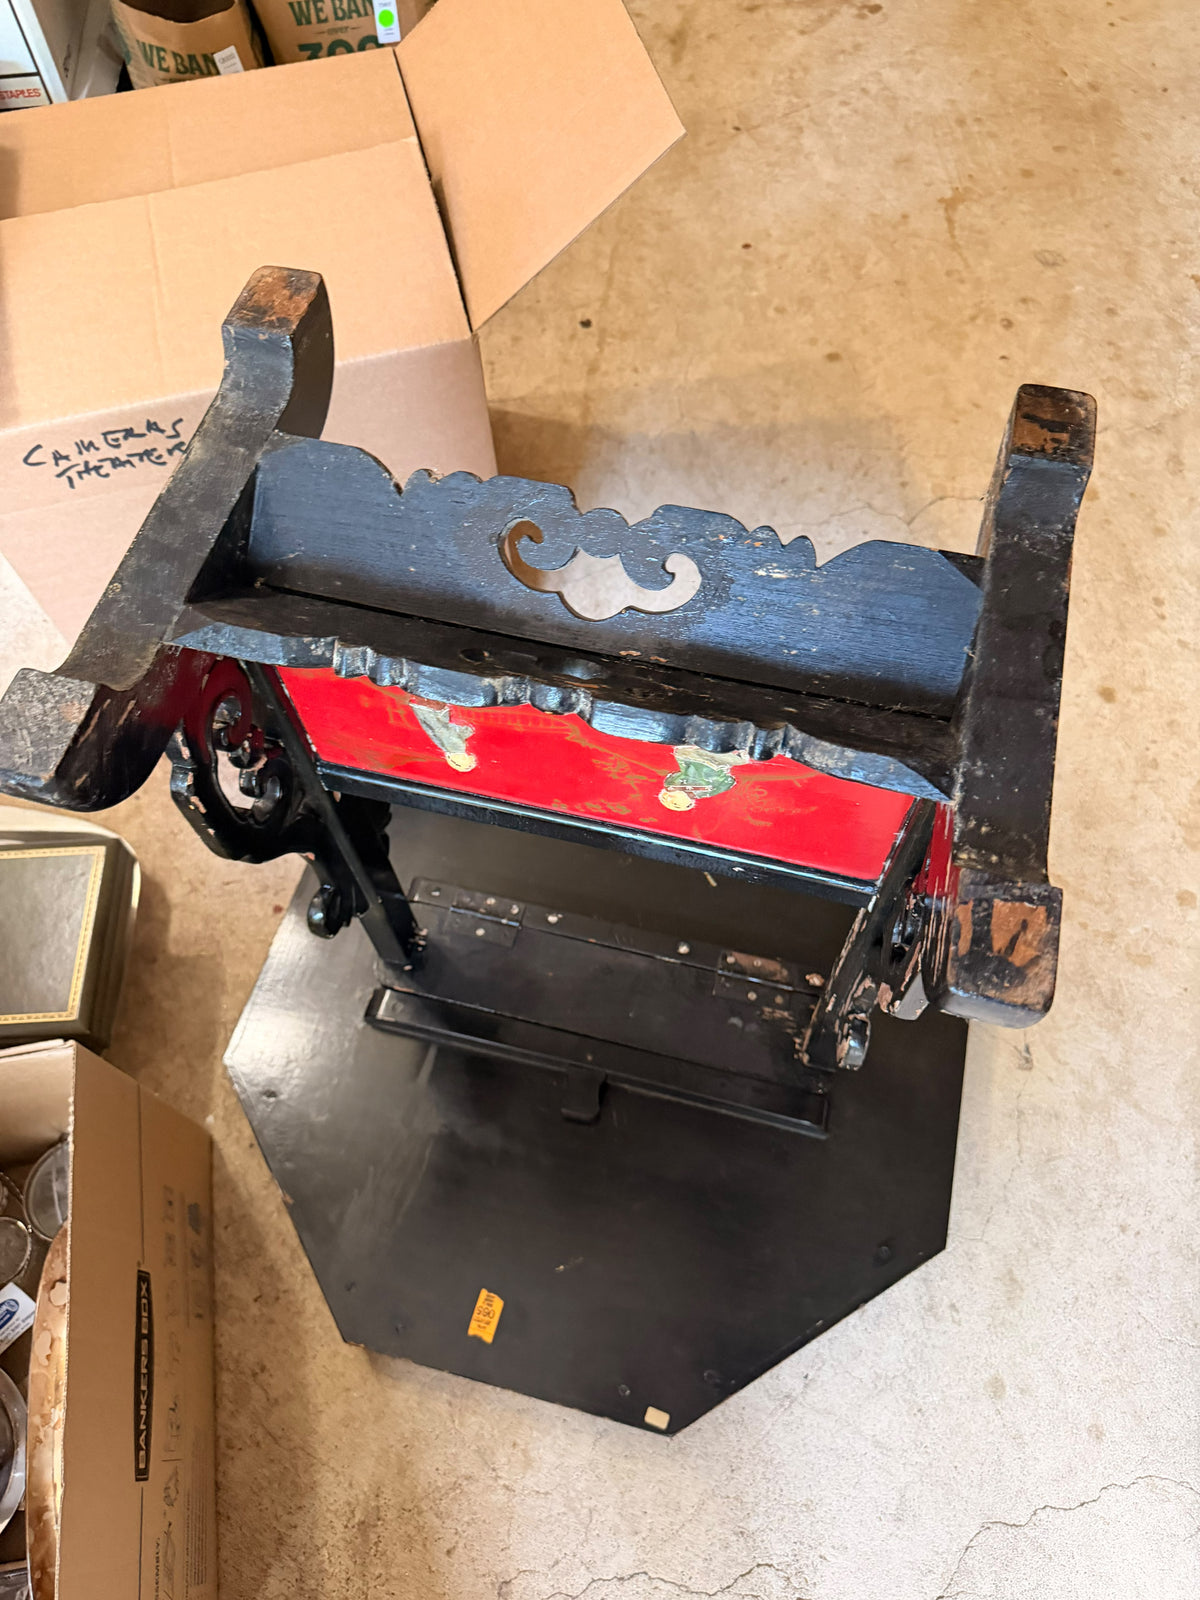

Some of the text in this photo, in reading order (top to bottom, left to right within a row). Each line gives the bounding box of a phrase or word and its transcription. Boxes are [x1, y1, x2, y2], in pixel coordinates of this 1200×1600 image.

[288, 0, 328, 26] WE
[136, 39, 170, 73] WE
[22, 418, 184, 468] CAMERAS
[139, 1280, 149, 1469] BANKERS BOX
